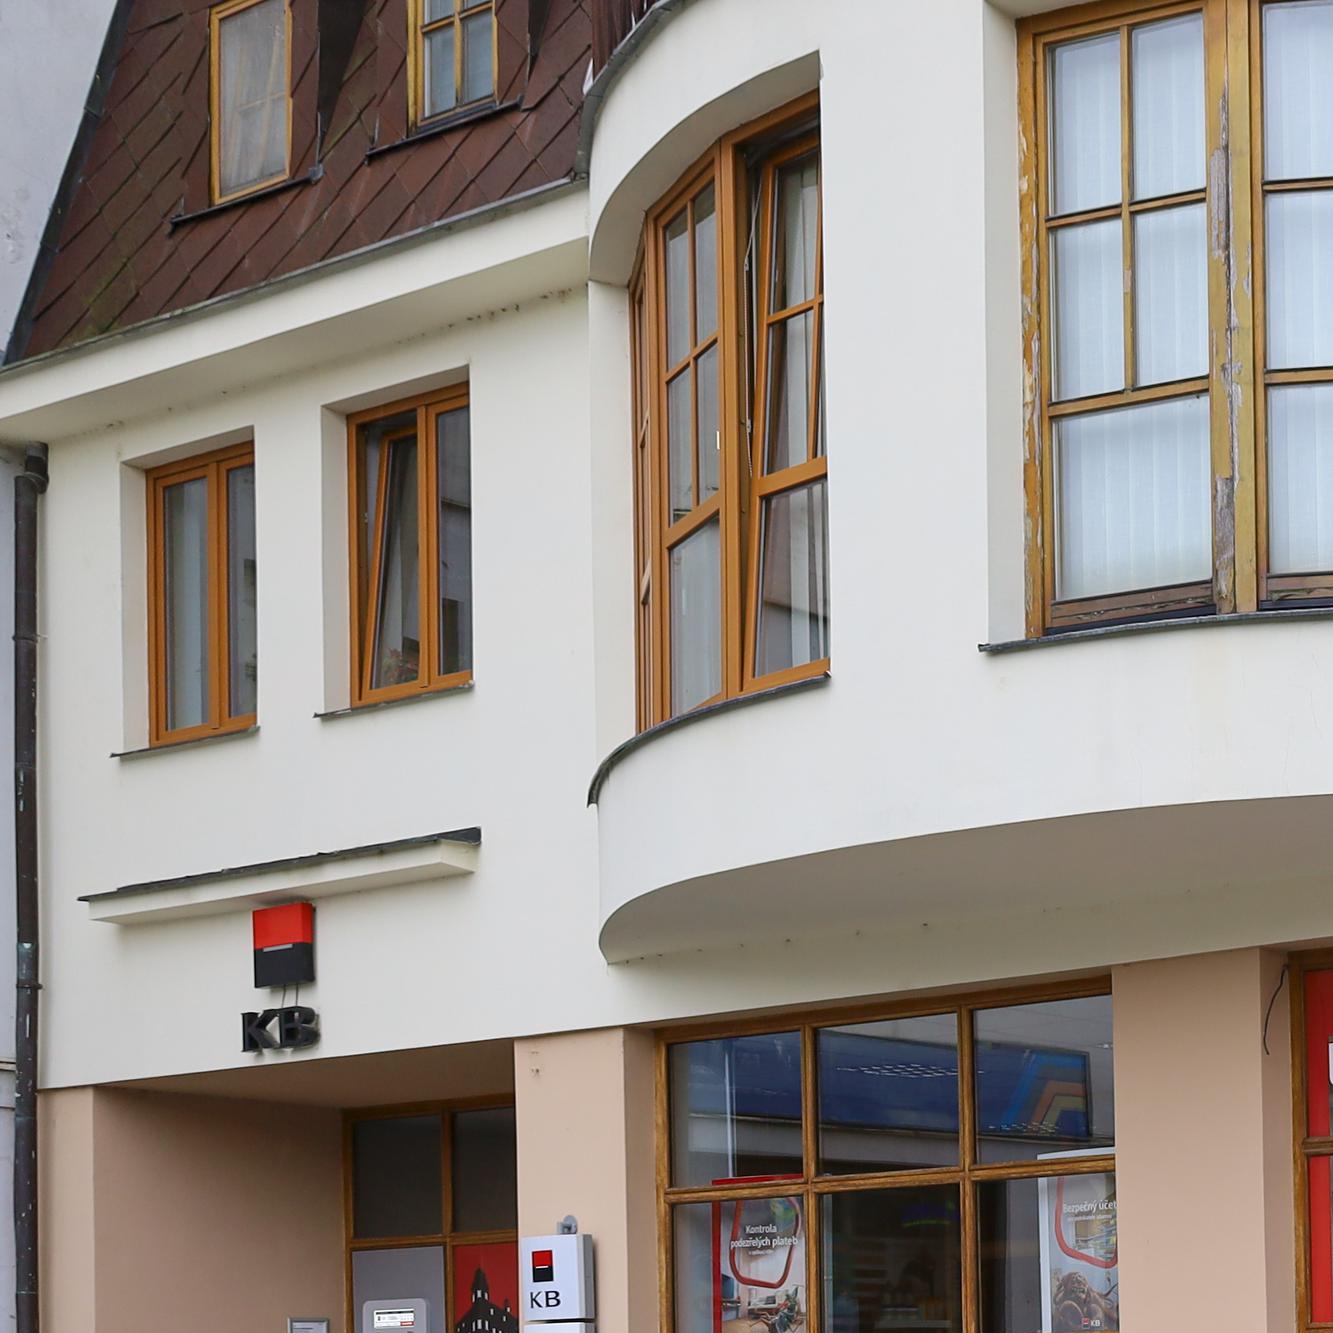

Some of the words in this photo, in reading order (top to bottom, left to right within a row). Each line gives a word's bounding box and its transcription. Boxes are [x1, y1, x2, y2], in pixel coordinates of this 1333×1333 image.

[240, 1005, 321, 1054] KB
[745, 1223, 778, 1234] Kontrola
[529, 1290, 561, 1309] KB
